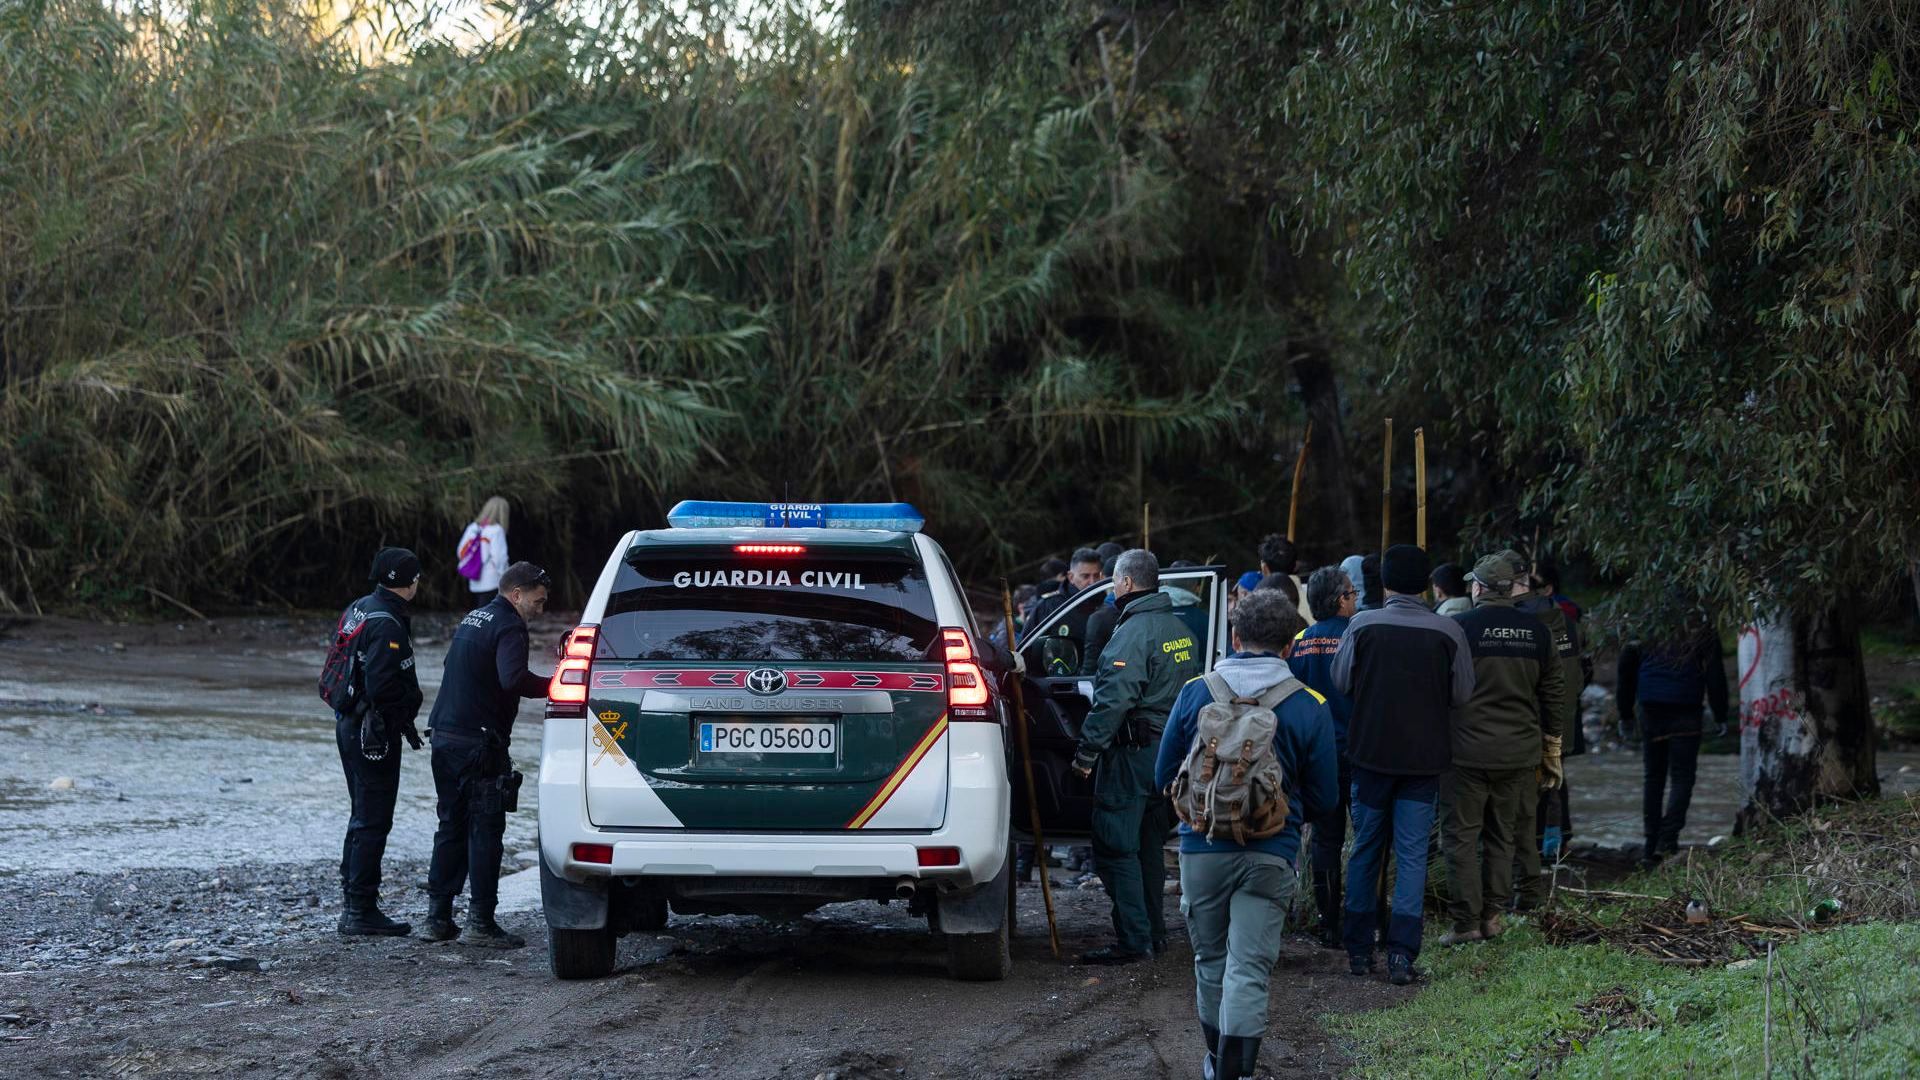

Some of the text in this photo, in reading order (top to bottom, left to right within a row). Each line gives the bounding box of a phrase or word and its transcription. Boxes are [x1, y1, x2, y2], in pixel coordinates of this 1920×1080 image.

[770, 503, 821, 511] GUARDIA
[780, 511, 811, 519] CIVIL
[673, 570, 866, 590] GUARDIA CIVIL
[1482, 627, 1534, 640] AGENTE
[1162, 637, 1193, 653] GUARDIA
[1174, 650, 1191, 663] CIVIL
[689, 696, 842, 709] LAND CRUISER
[715, 727, 755, 749] PGC
